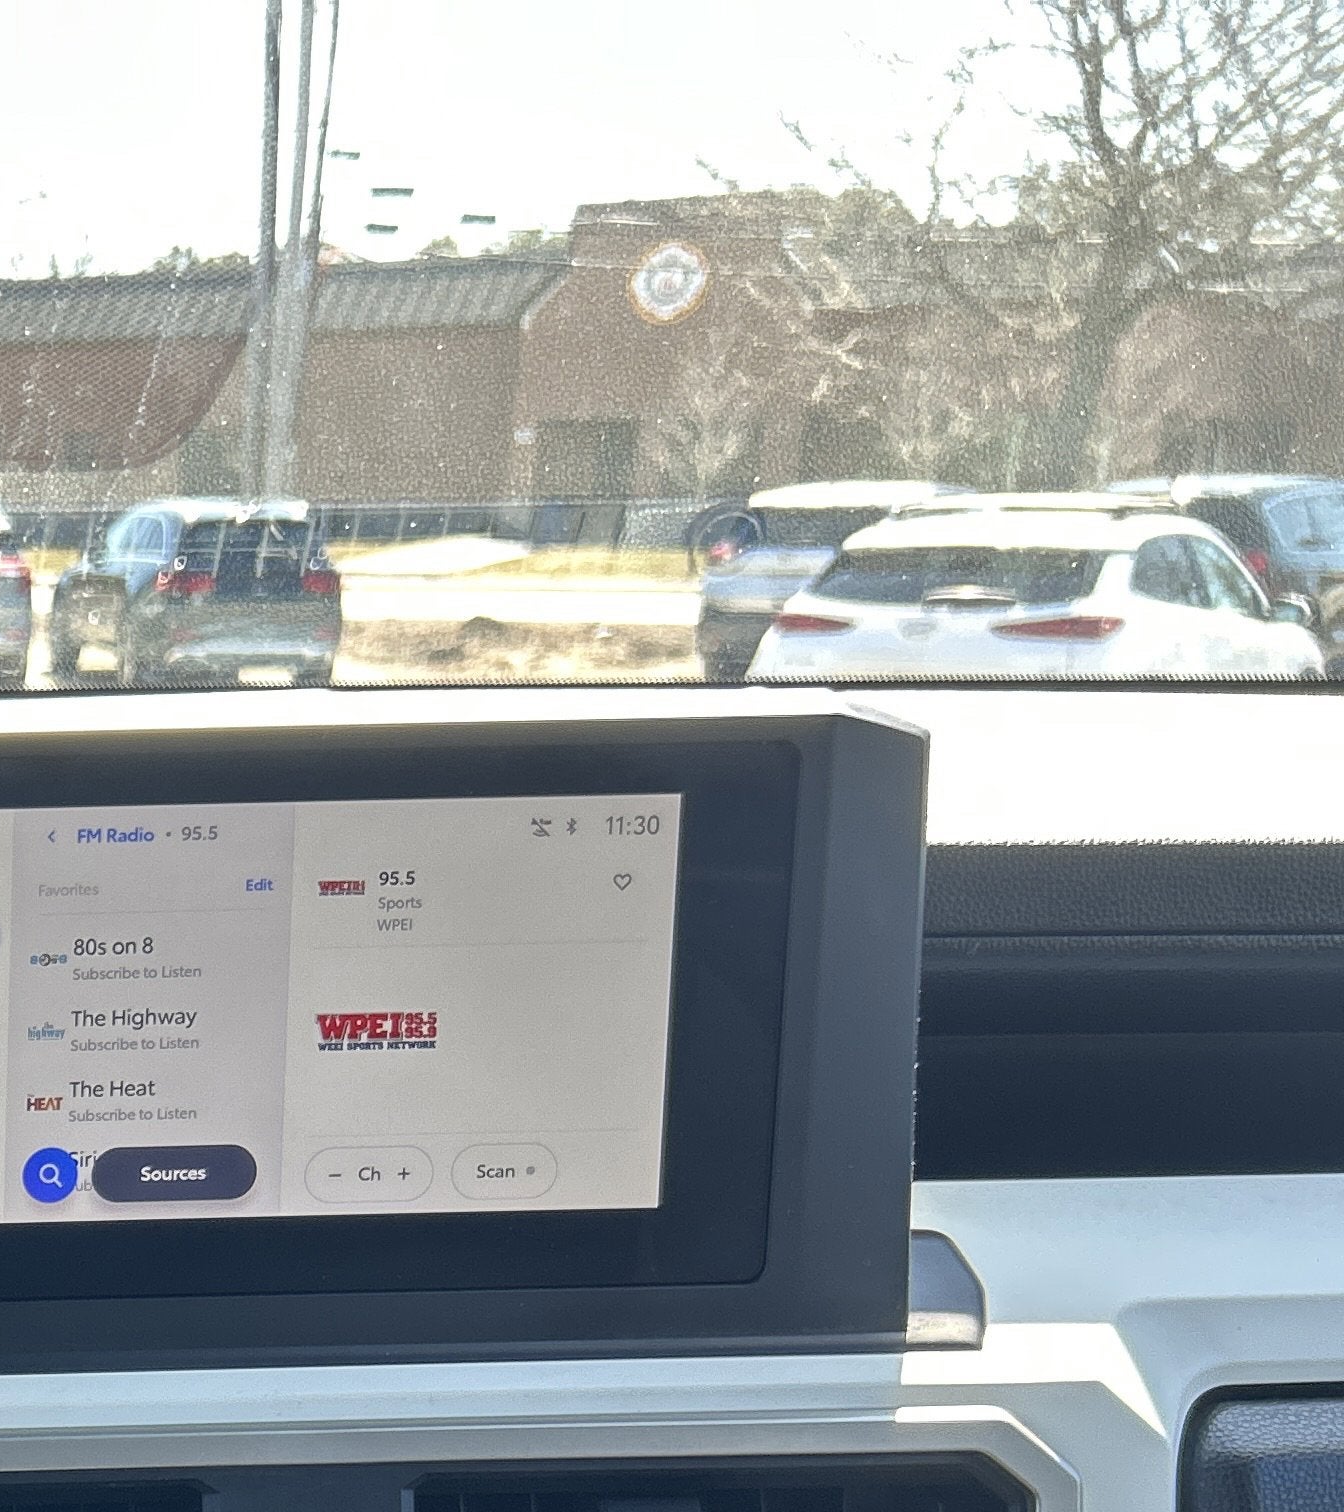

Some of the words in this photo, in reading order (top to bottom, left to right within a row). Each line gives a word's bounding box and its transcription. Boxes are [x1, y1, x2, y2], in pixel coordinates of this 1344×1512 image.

[605, 815, 659, 835] 11:30
[77, 828, 101, 844] FM
[106, 827, 155, 843] Radio
[181, 826, 218, 841] 95.5
[246, 879, 273, 891] Edit
[379, 871, 416, 886] 95.5
[38, 884, 99, 897] Favorites
[378, 897, 422, 913] Sports
[376, 918, 413, 931] WPEI
[73, 938, 107, 956] 80s
[112, 941, 136, 955] on
[142, 937, 154, 954] 8
[72, 967, 140, 981] Subscribe
[144, 967, 157, 979] to
[162, 966, 201, 978] Listen
[71, 1010, 106, 1027] The
[112, 1008, 197, 1030] Highway
[315, 1012, 404, 1041] WPEI
[70, 1039, 138, 1051] Subscribe
[141, 1039, 155, 1050] to
[159, 1038, 199, 1050] Listen
[347, 1041, 383, 1050] SPORTS
[387, 1041, 436, 1050] NETWORK
[69, 1081, 104, 1097] The
[110, 1080, 155, 1096] Heat
[27, 1097, 63, 1111] HEAT
[68, 1110, 136, 1122] Subscribe
[139, 1111, 153, 1121] to
[157, 1108, 197, 1120] Listen
[140, 1166, 207, 1182] Sources
[358, 1167, 381, 1181] Ch
[477, 1165, 515, 1179] Scan
